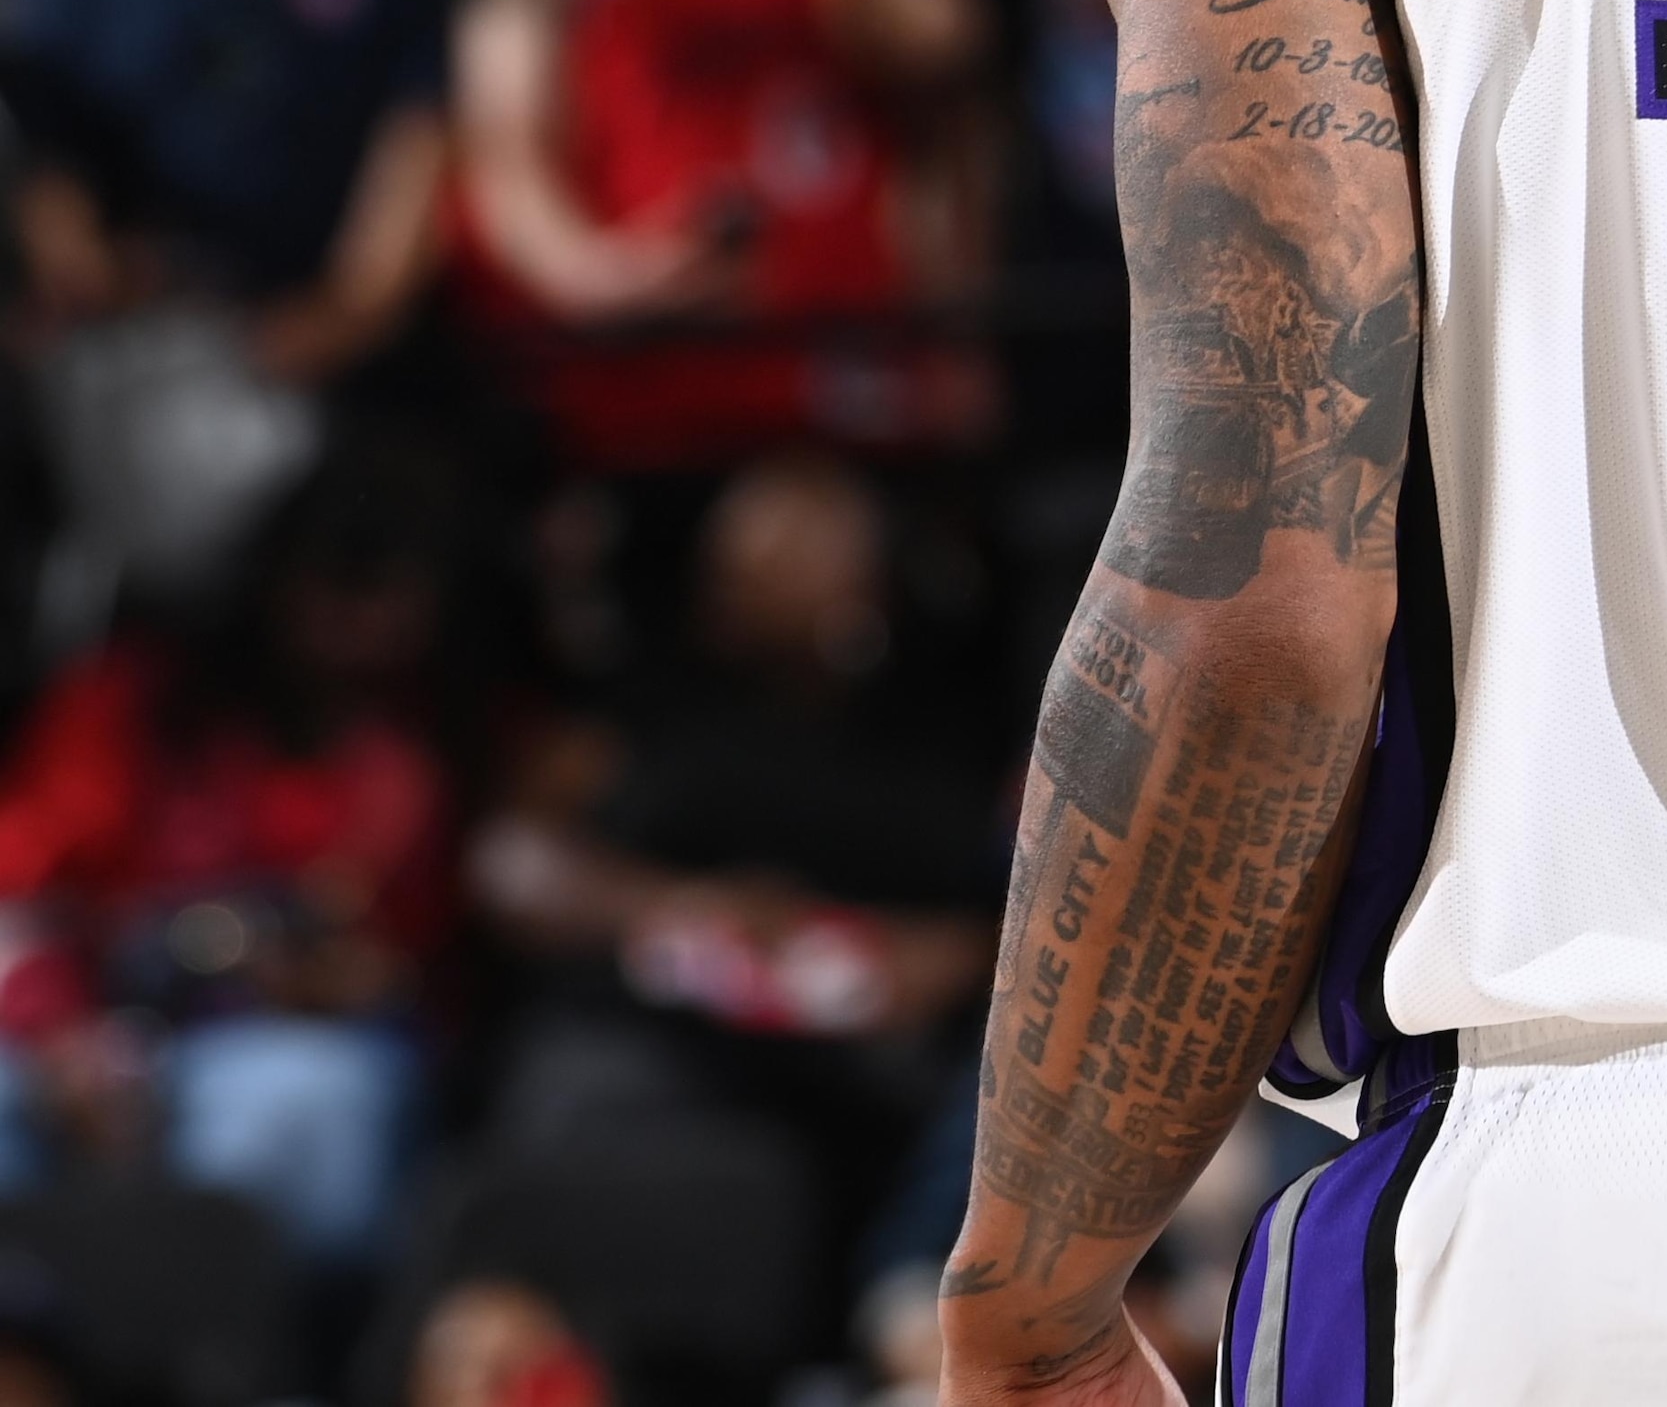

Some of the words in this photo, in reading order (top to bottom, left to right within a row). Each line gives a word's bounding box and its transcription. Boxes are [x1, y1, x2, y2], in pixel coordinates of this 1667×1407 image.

[1234, 36, 1391, 92] 10-3-19
[1017, 946, 1071, 1067] BLUE
[1052, 831, 1110, 944] CITY
